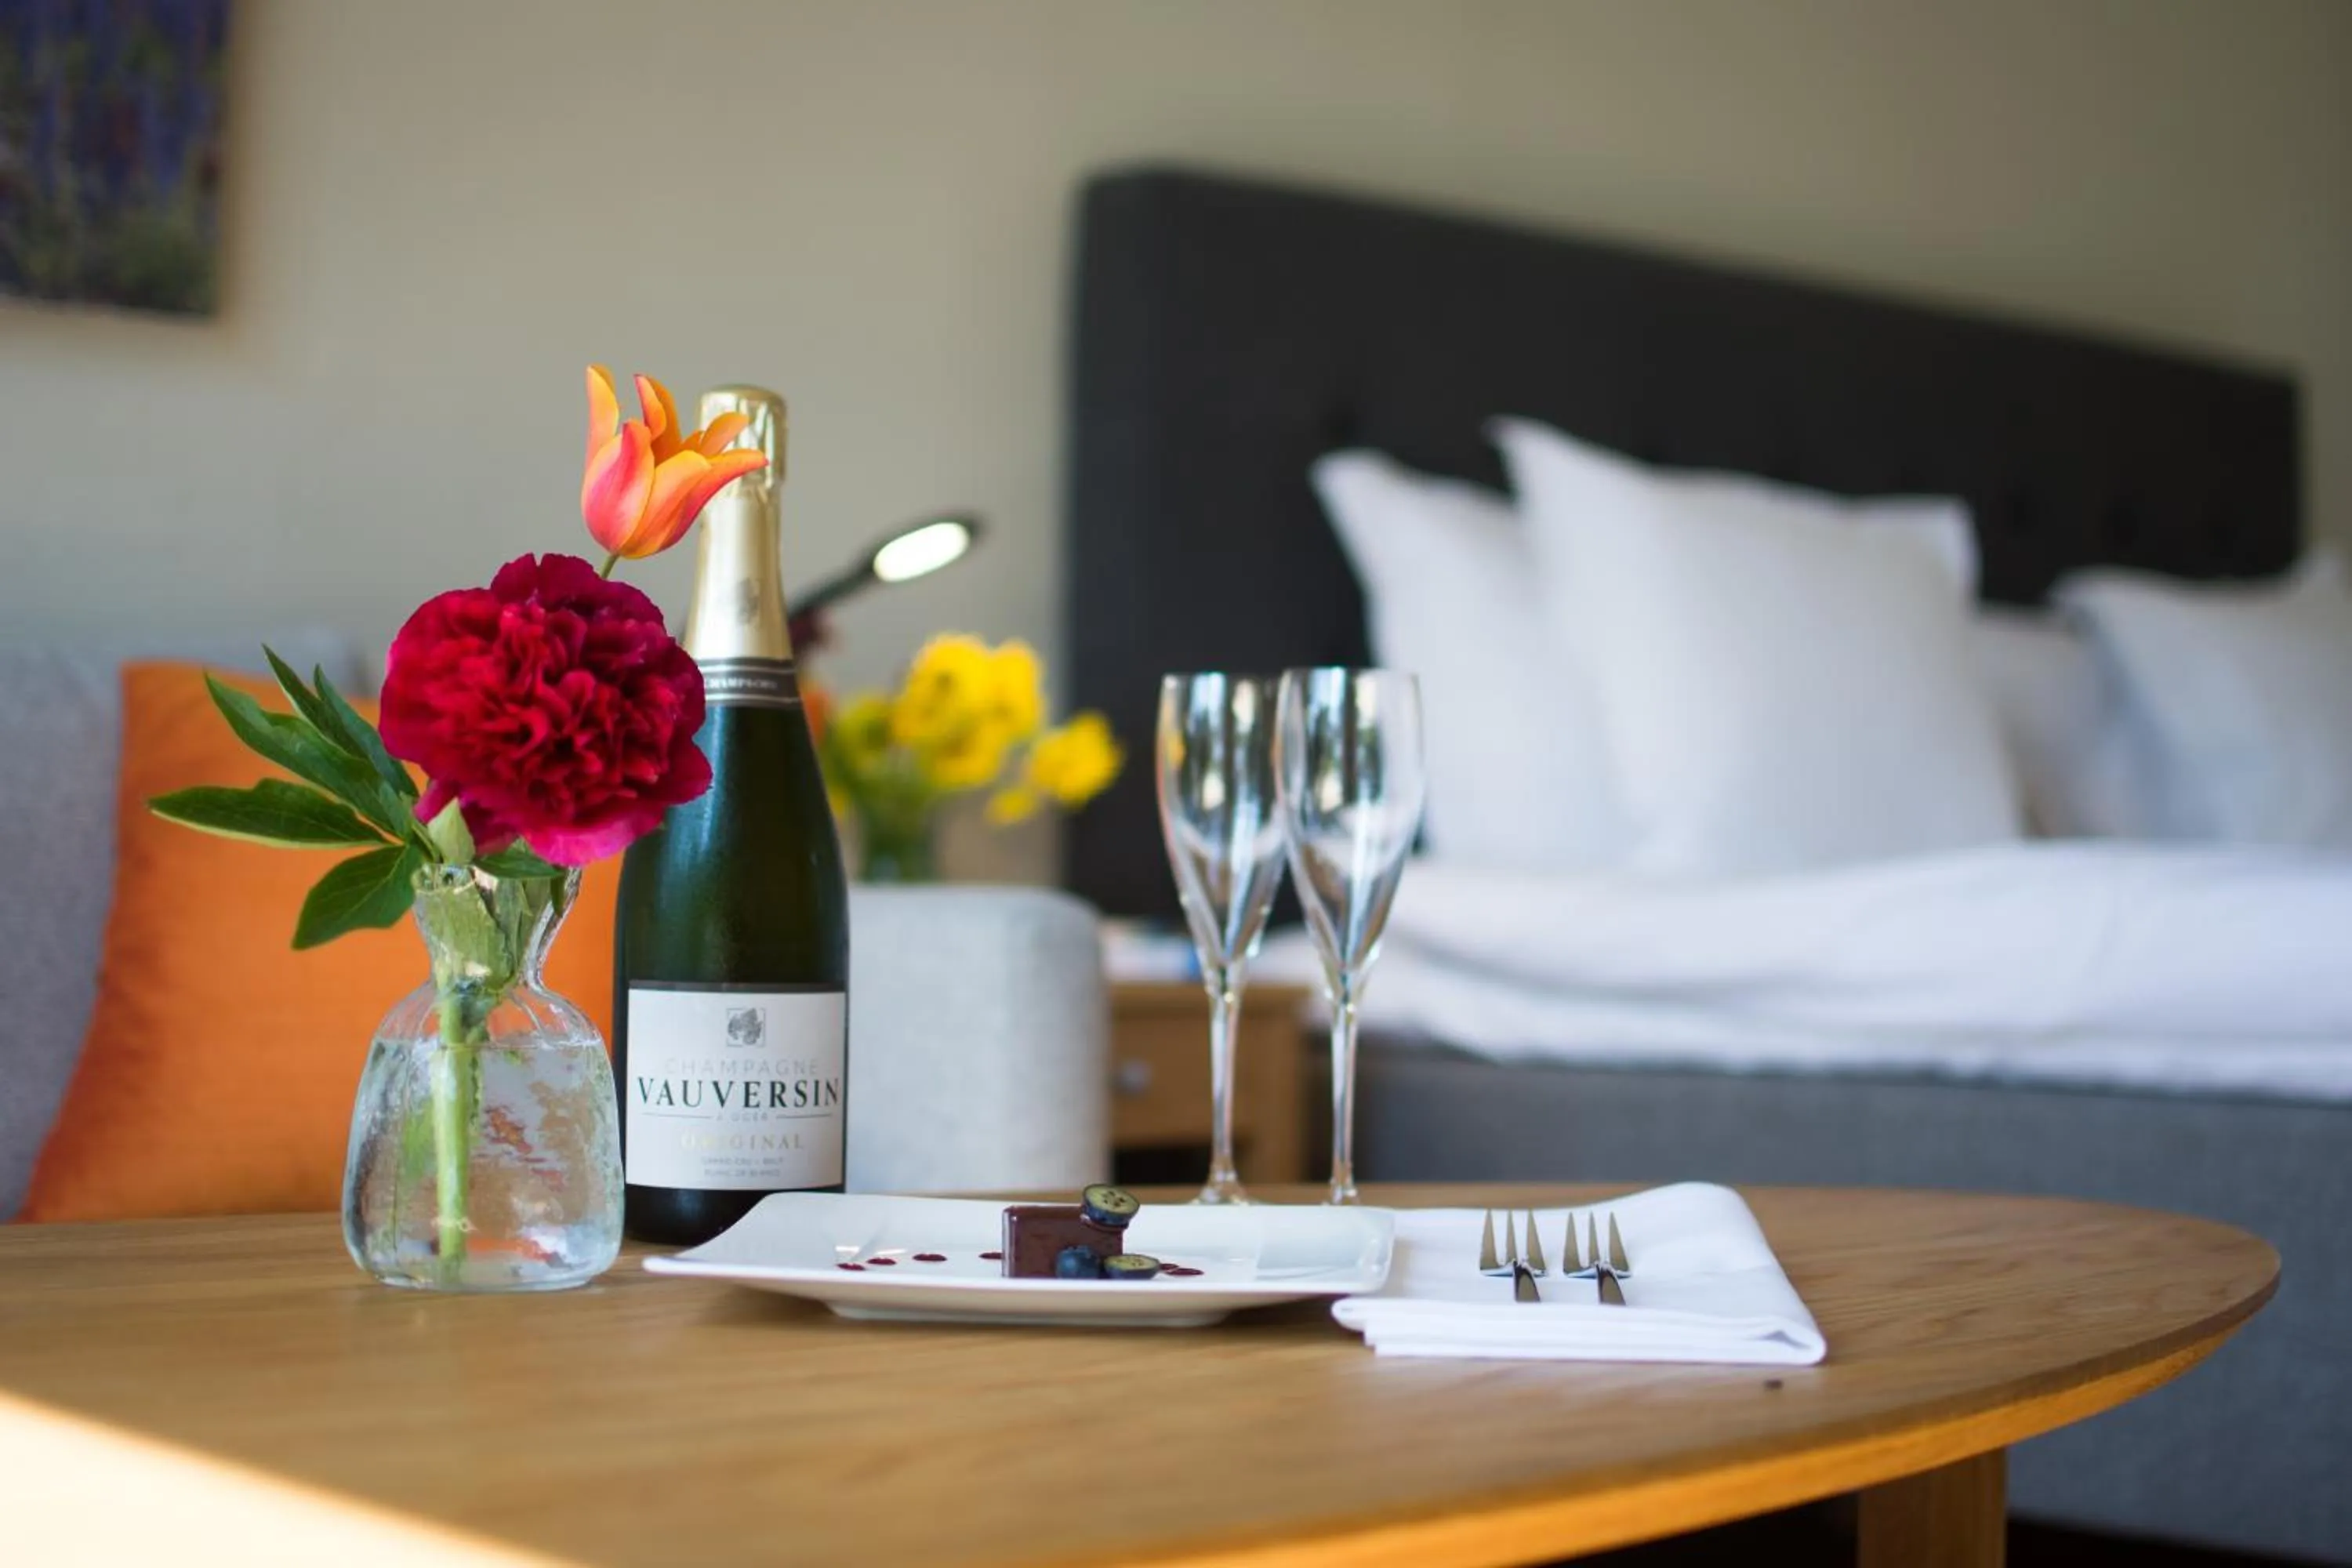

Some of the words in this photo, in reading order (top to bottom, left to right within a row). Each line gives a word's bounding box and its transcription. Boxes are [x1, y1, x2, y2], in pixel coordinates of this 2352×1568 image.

[664, 1058, 818, 1076] CHAMPAGNE
[637, 1076, 840, 1109] VAUVERSIN
[680, 1133, 804, 1151] OGINAL
